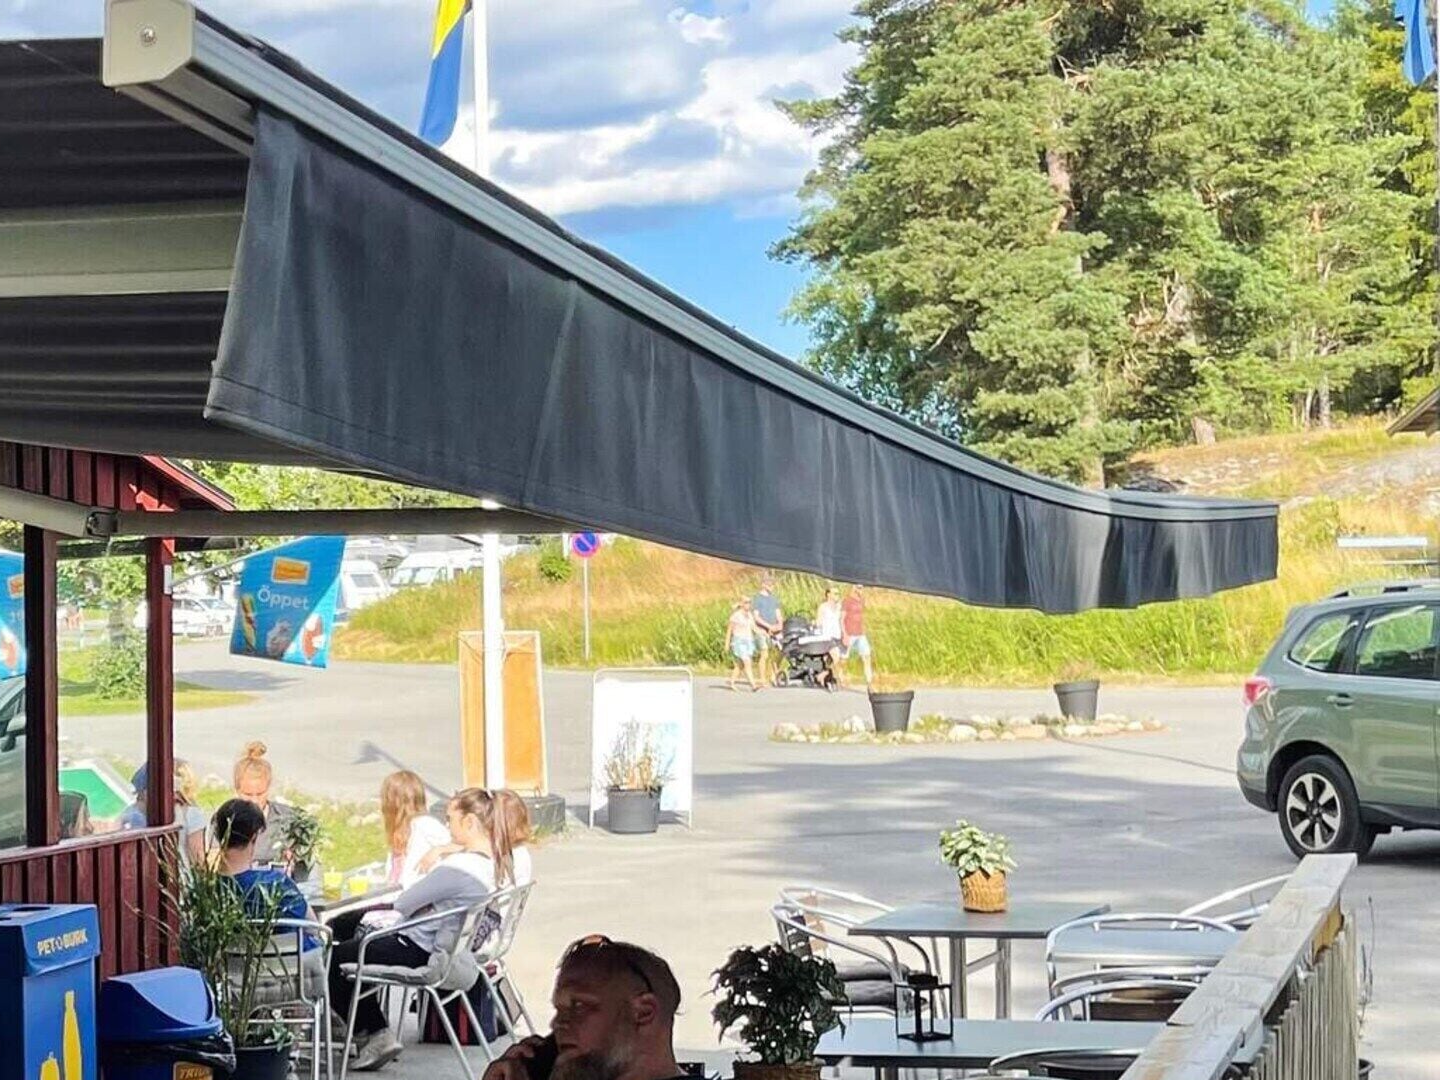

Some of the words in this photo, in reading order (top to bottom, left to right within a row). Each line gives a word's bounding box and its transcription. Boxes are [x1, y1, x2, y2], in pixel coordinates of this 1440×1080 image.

[257, 585, 310, 610] Öppet
[37, 938, 56, 956] PET
[63, 929, 87, 949] BURK
